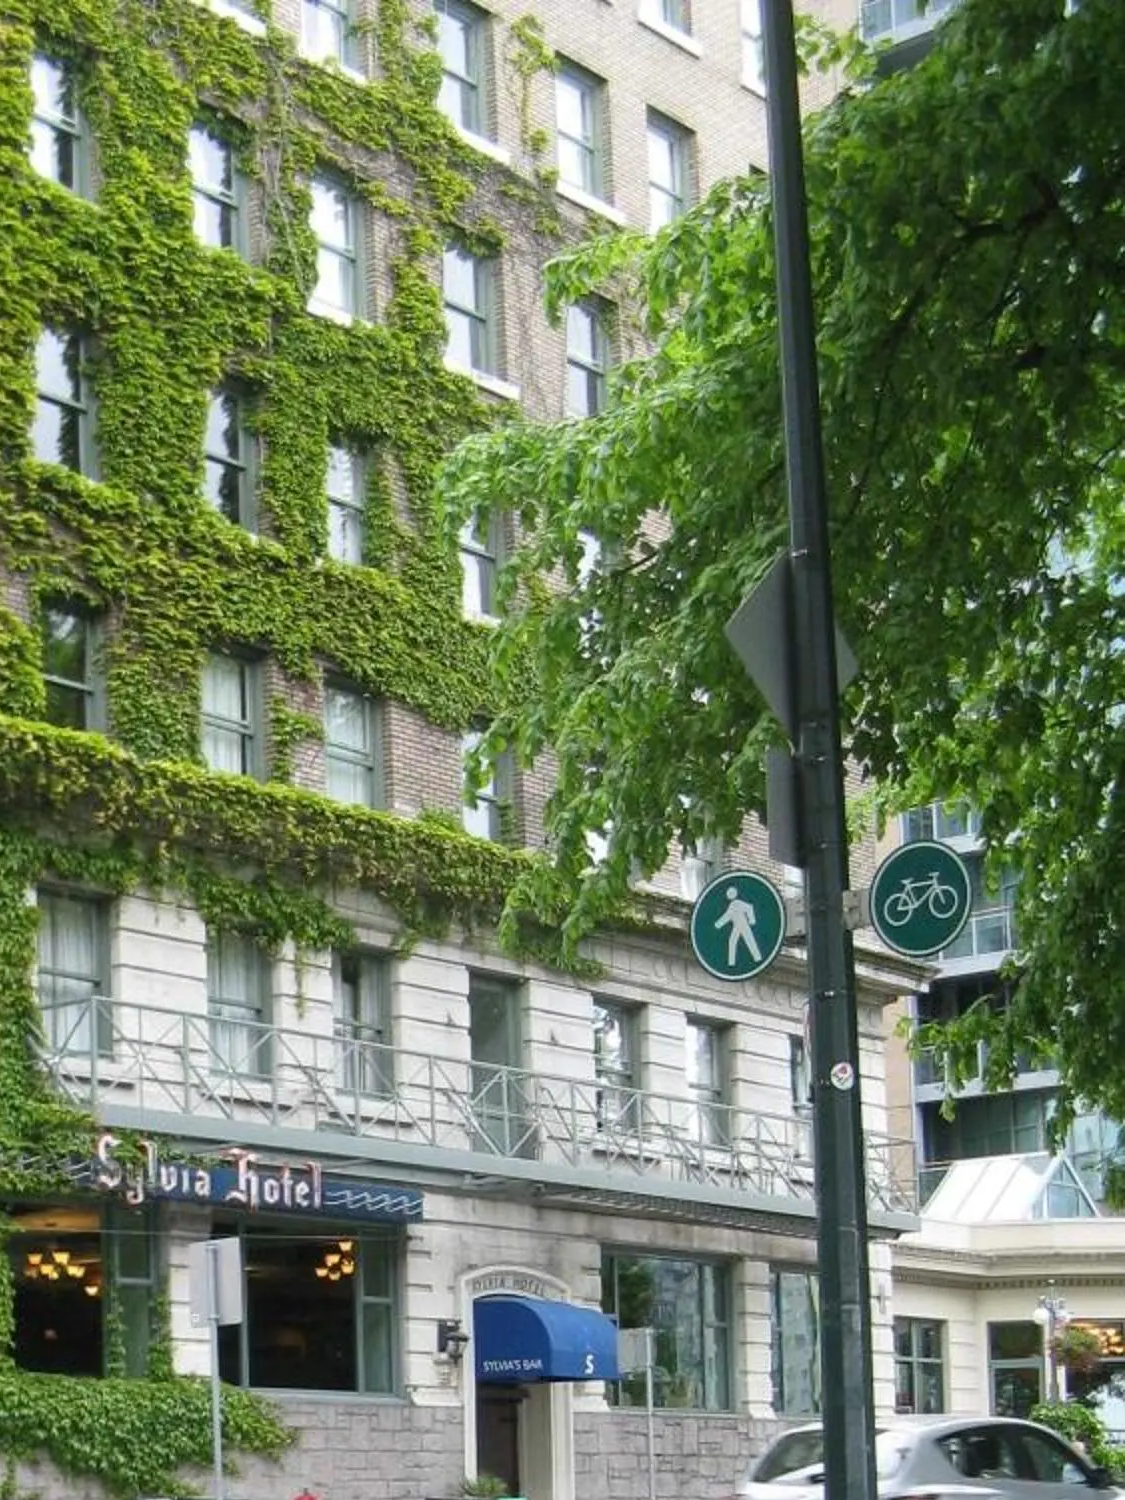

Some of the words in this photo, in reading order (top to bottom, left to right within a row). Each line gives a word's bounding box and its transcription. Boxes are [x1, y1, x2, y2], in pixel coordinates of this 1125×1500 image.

[95, 1133, 212, 1206] Sylvia
[220, 1147, 323, 1216] Hotel
[482, 1359, 522, 1373] SYLVIA'S
[522, 1359, 544, 1372] BAR
[584, 1354, 595, 1375] S
